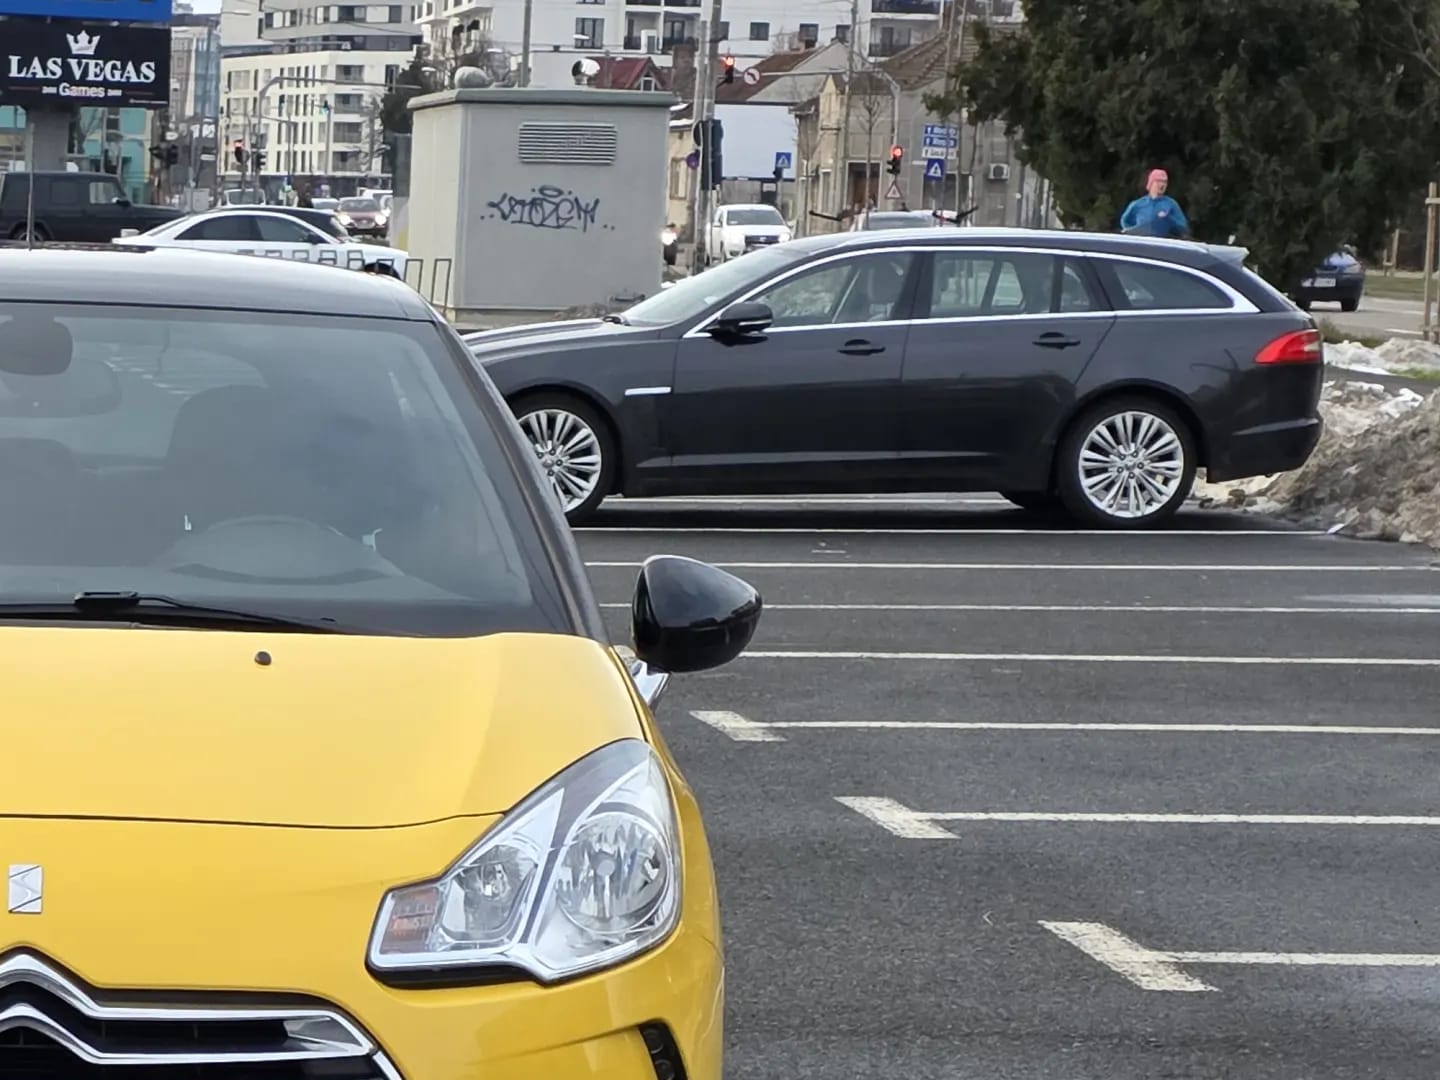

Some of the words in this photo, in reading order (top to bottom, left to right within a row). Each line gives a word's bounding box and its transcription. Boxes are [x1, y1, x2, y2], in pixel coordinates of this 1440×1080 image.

[9, 55, 62, 79] LAS
[67, 57, 156, 83] VEGAS
[59, 82, 105, 98] Games
